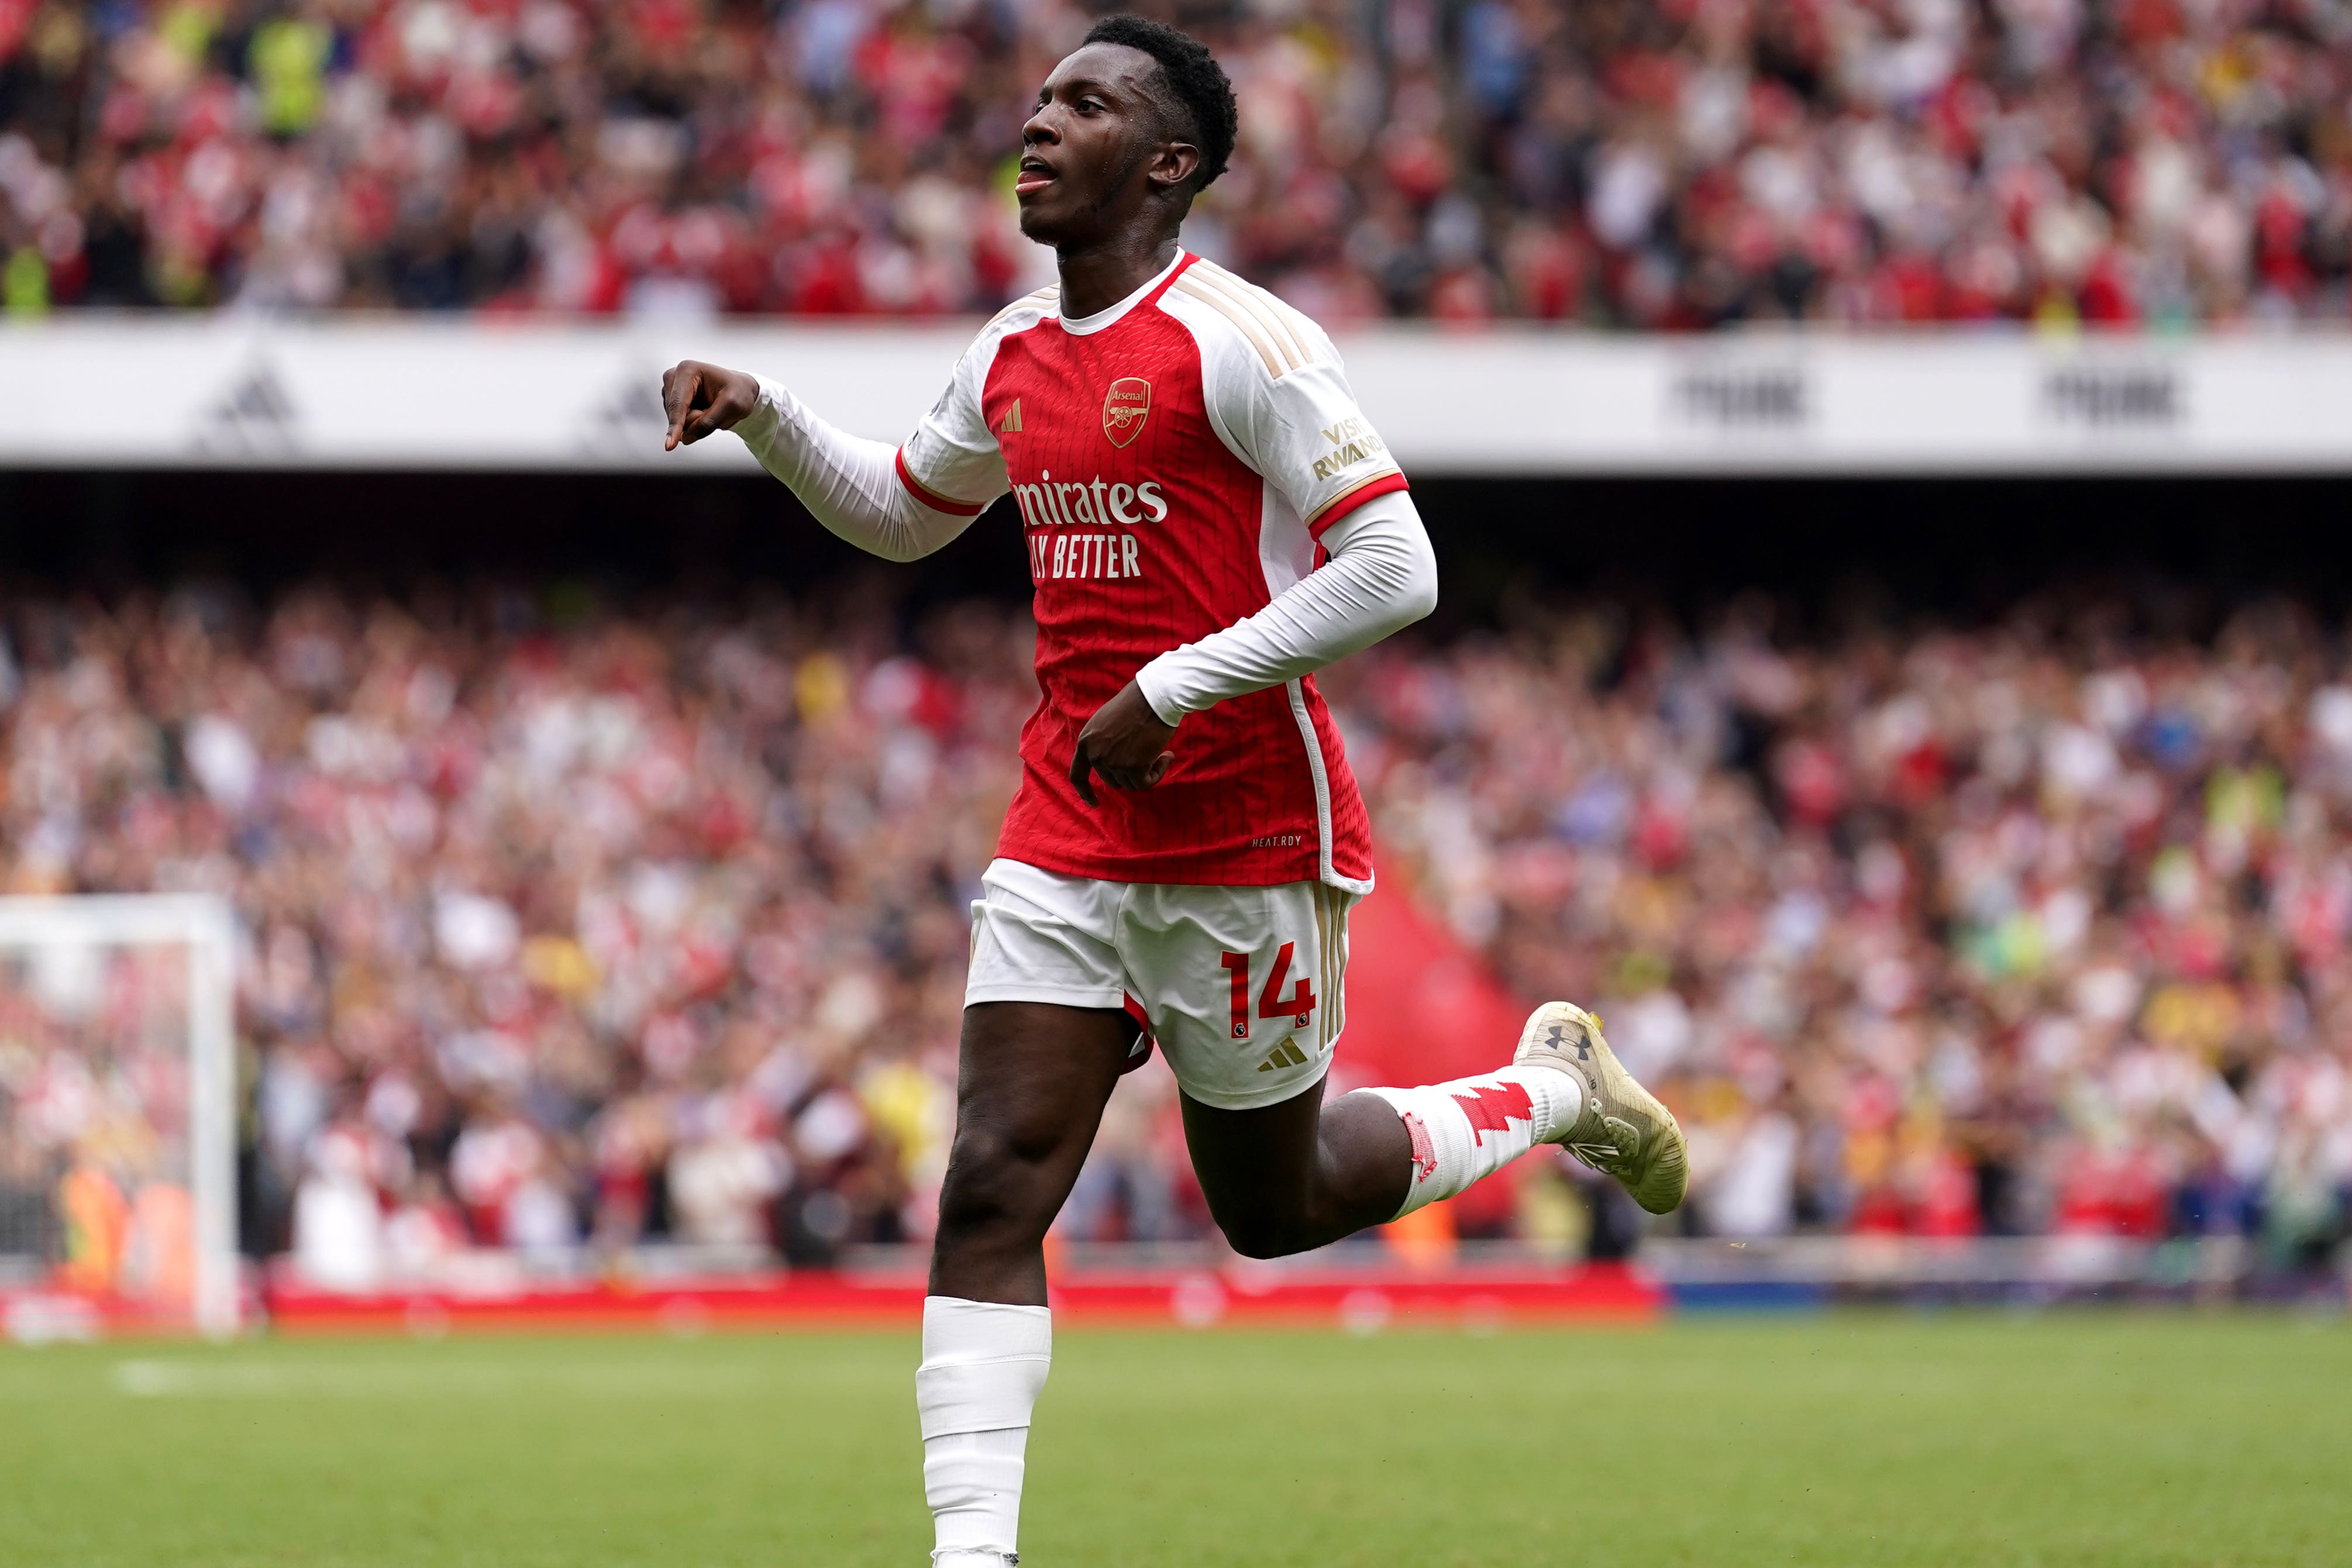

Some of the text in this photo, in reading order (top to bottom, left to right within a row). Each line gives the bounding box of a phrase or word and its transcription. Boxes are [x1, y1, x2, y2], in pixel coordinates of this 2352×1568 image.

[1111, 390, 1144, 401] Arsenal
[1007, 469, 1168, 526] mirates
[1028, 535, 1141, 578] LY BETTER
[1252, 835, 1301, 847] HEAT.RDY
[1221, 940, 1316, 1039] 14
